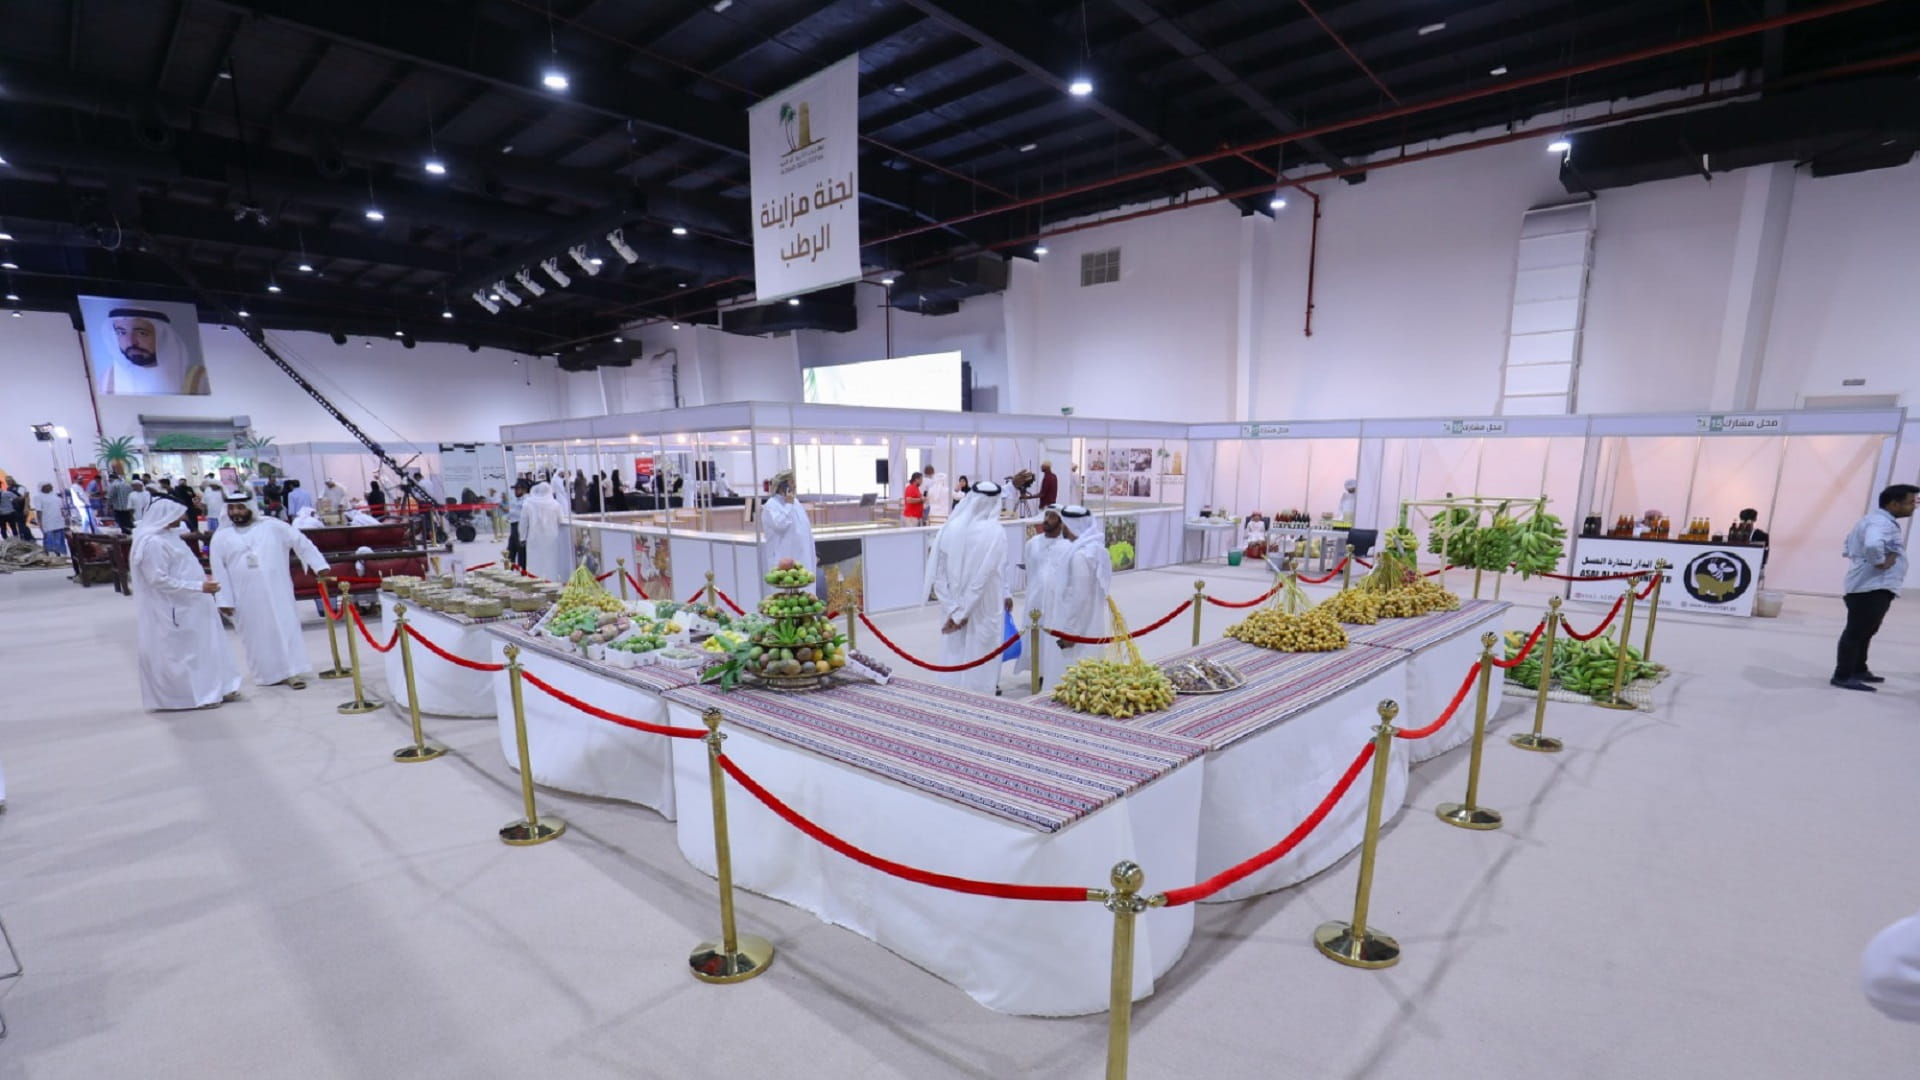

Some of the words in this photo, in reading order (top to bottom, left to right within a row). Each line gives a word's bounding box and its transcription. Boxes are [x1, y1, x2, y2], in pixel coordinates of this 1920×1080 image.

[814, 171, 854, 210] لجنة
[760, 192, 810, 229] مزاينة
[780, 223, 831, 269] الرطب
[1722, 417, 1754, 430] مشارك
[1756, 419, 1778, 429] محل
